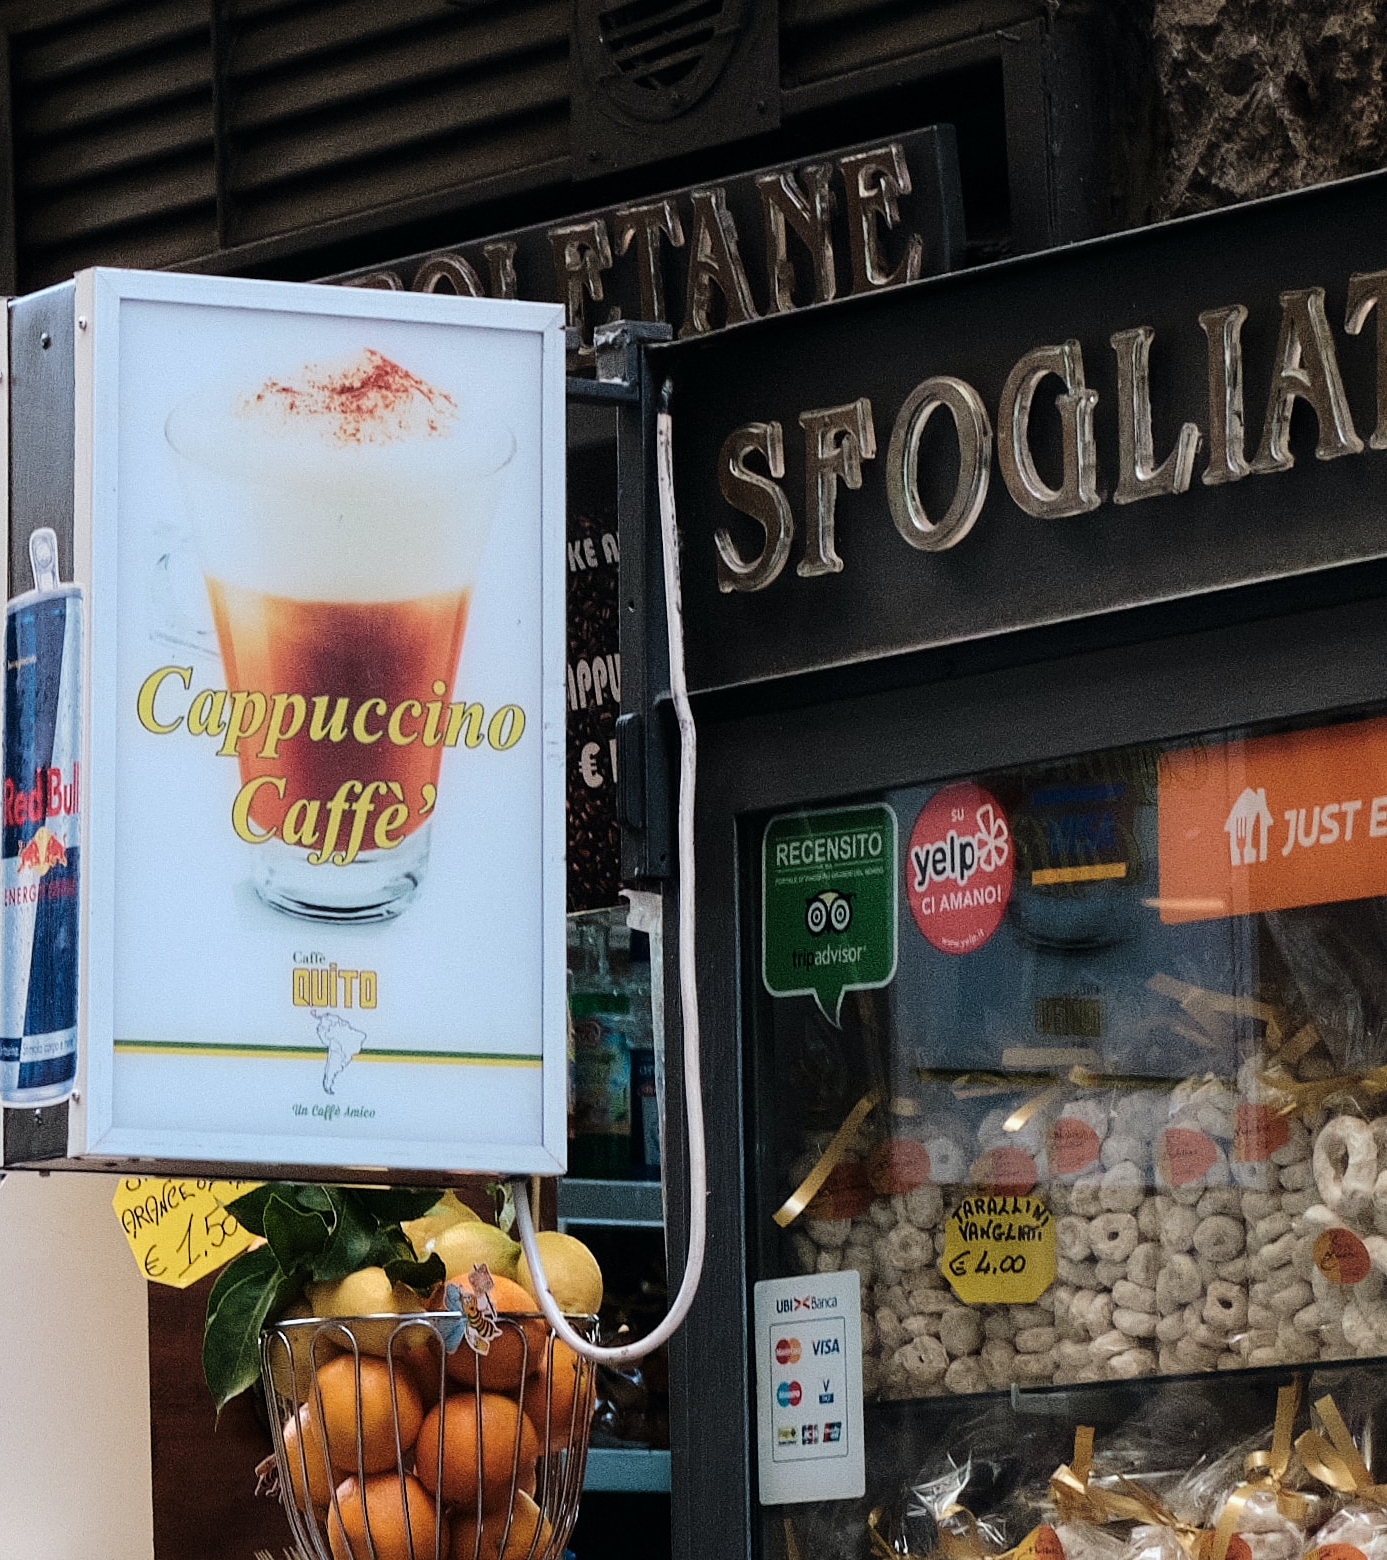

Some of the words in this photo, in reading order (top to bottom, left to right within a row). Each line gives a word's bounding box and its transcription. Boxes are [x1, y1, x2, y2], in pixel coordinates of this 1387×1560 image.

[135, 665, 527, 761] Cappuccino
[3, 767, 43, 827] Red
[47, 761, 80, 818] Bull
[950, 808, 965, 823] SU
[1281, 799, 1362, 857] JUST
[775, 831, 883, 867] RECENSITO
[913, 834, 976, 887] yelp
[921, 897, 935, 916] CI
[938, 884, 1002, 913] AMANO!
[292, 950, 326, 965] Caffè
[791, 944, 864, 971] tripadvisor
[292, 1103, 309, 1117] Un
[951, 1197, 1052, 1228] TARALLINI
[776, 1298, 793, 1314] UBI
[810, 1295, 838, 1310] Banca
[812, 1337, 840, 1356] VISA
